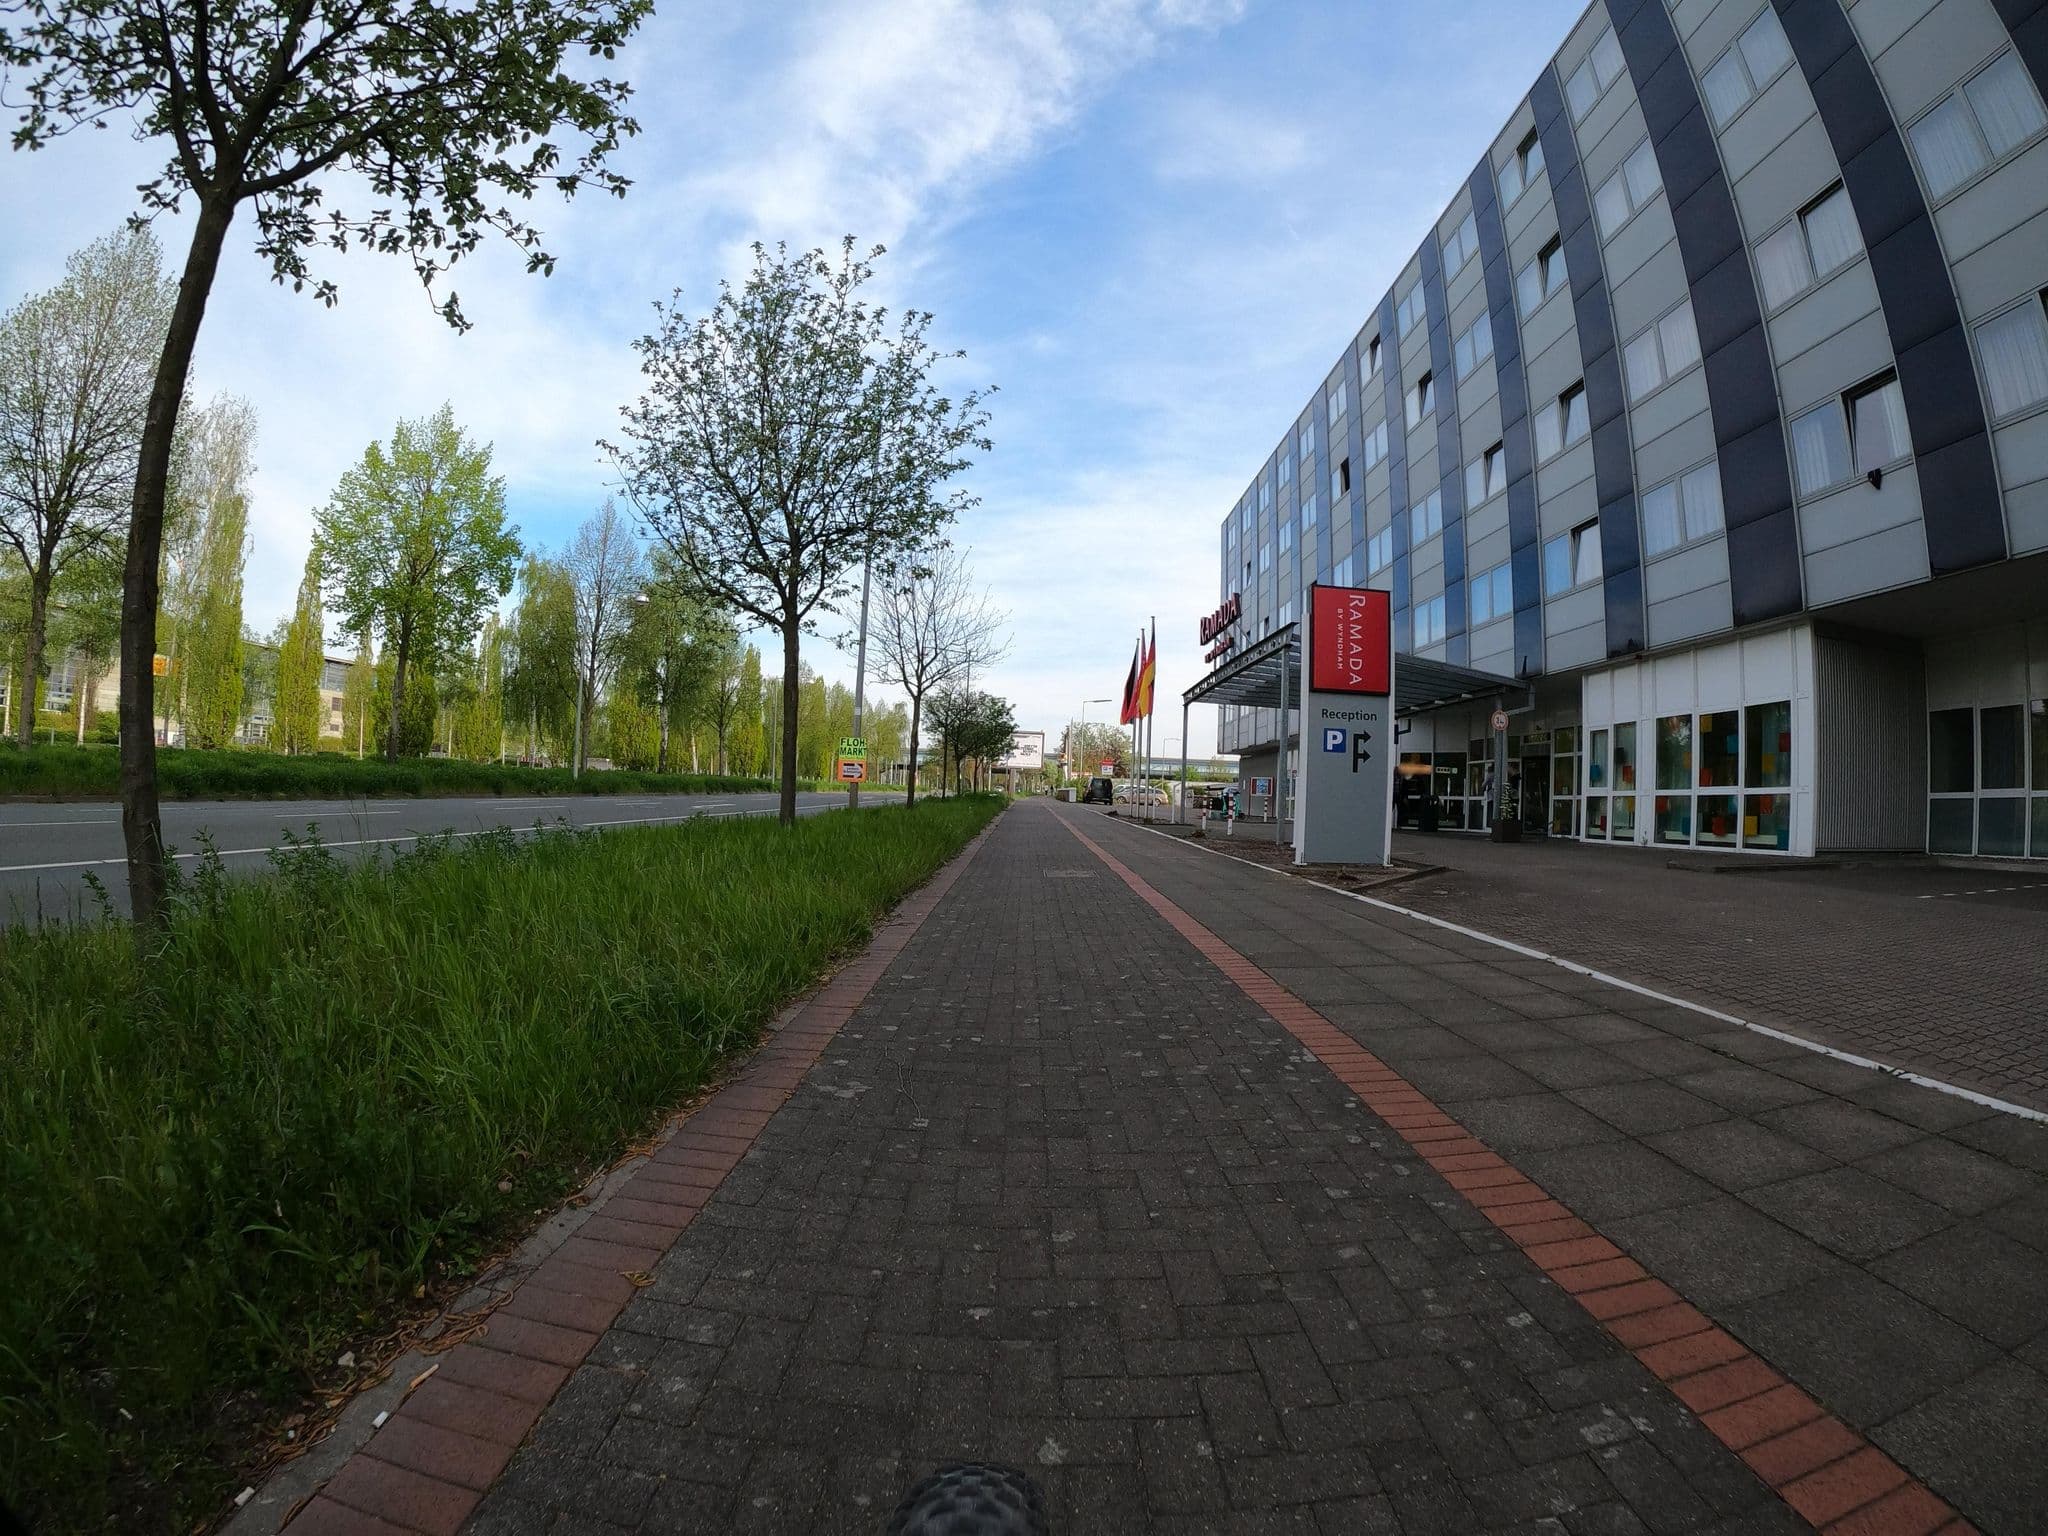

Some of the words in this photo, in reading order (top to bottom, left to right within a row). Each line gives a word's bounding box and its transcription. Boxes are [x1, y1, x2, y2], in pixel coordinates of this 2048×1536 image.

[1200, 593, 1241, 646] RAMADA
[1337, 608, 1344, 619] BY
[1349, 595, 1366, 685] RAMADA
[1321, 708, 1377, 722] Reception
[1326, 730, 1343, 750] P
[839, 747, 867, 756] MARKT
